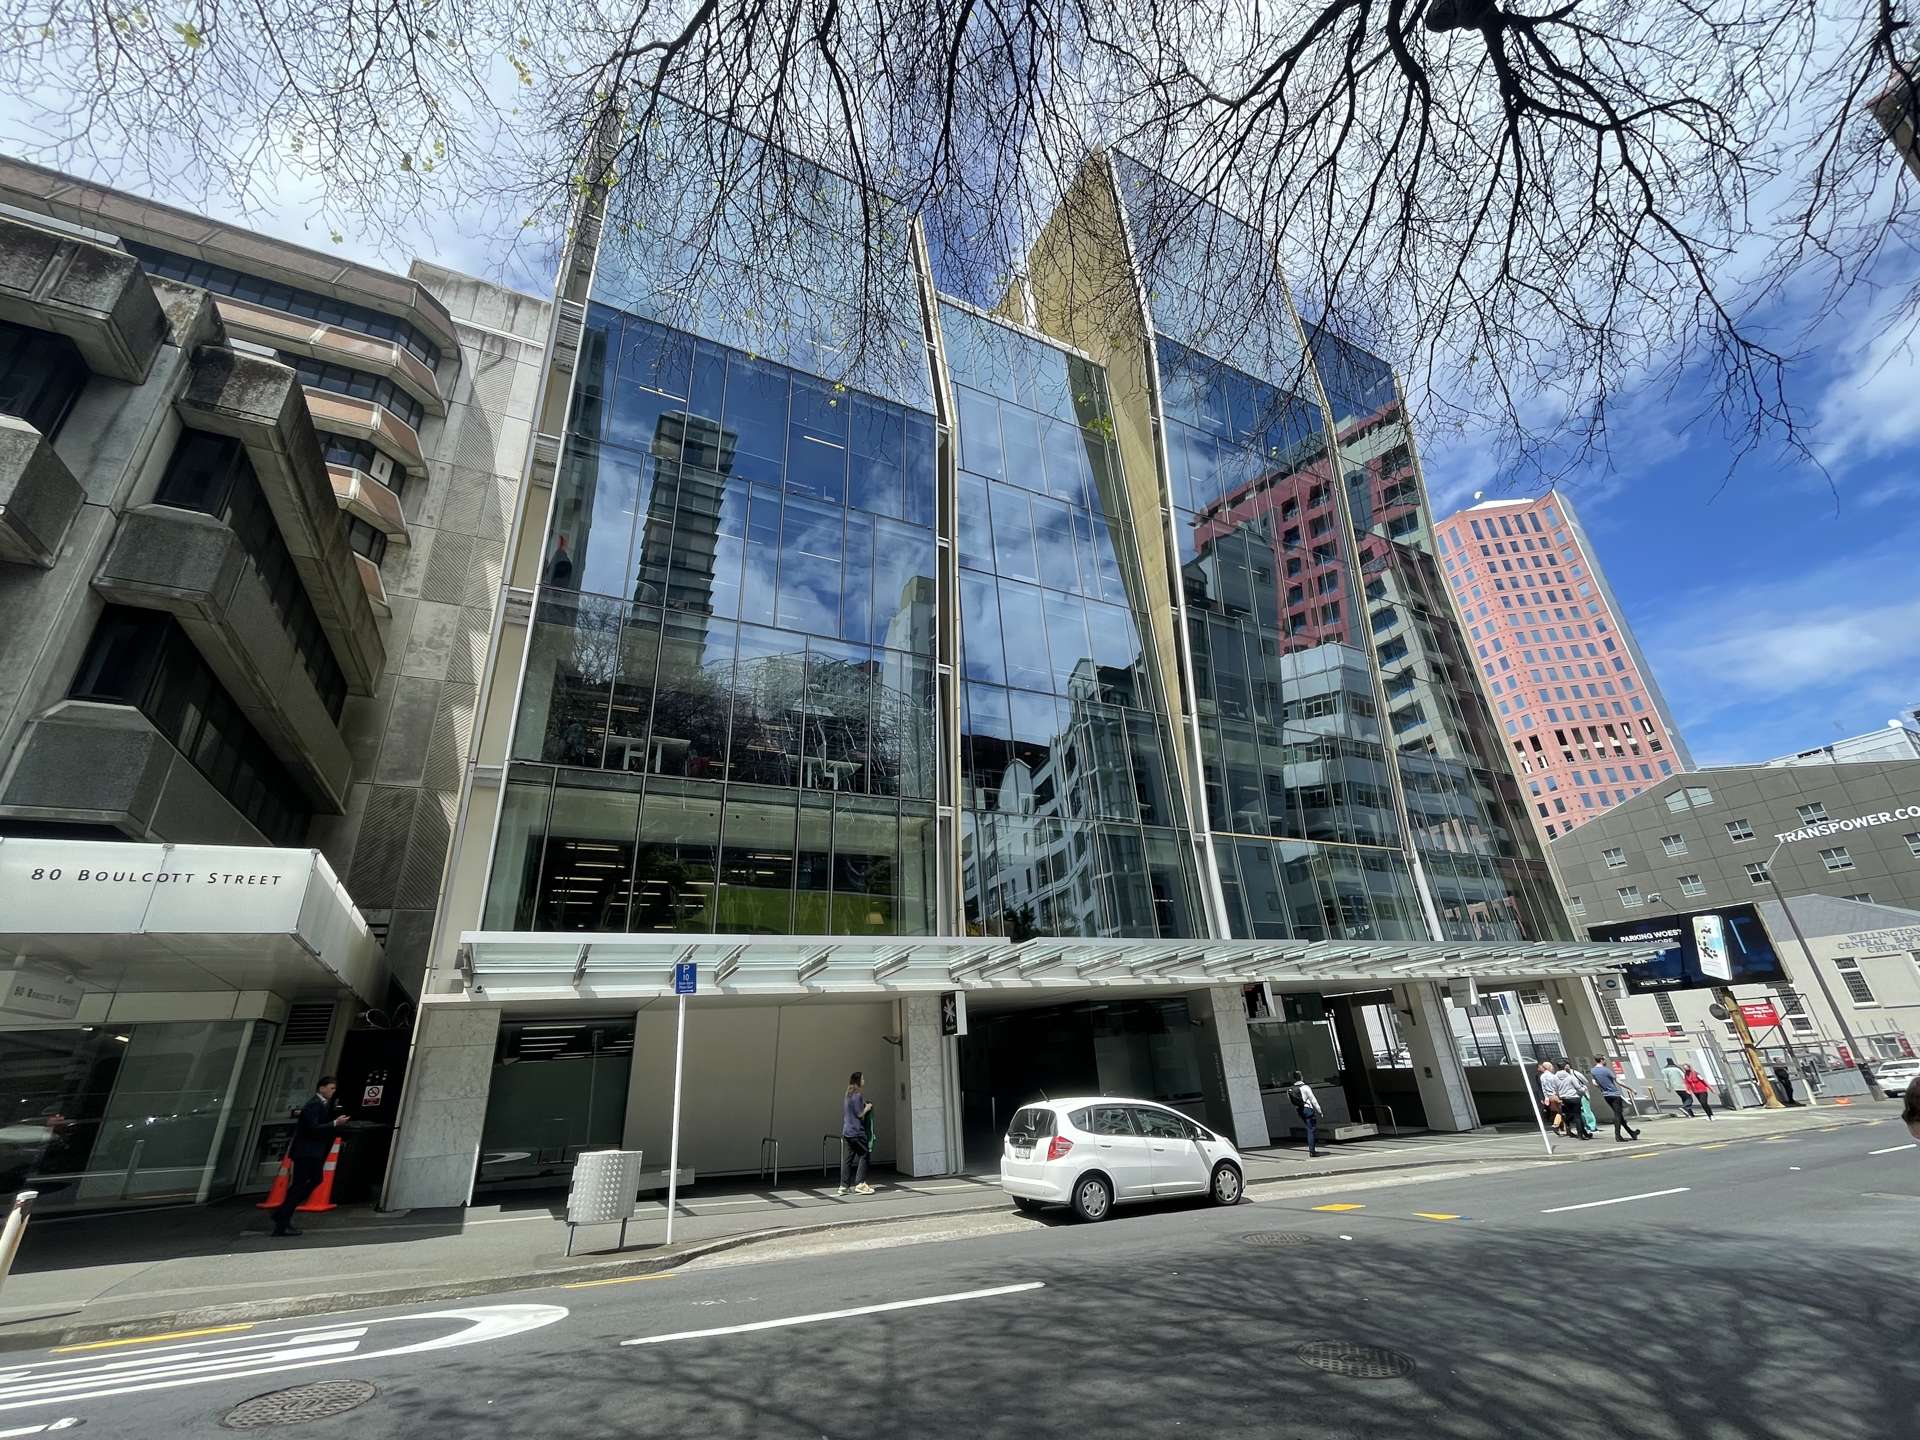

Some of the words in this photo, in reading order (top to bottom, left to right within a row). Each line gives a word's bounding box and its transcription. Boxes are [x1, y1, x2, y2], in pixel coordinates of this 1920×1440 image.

[31, 868, 62, 881] 80
[77, 869, 195, 884] BOULCOTT
[207, 872, 282, 886] STREET
[1620, 932, 1653, 943] PARKING
[1653, 928, 1682, 938] WOES?
[1867, 942, 1915, 953] CHURCH
[683, 964, 690, 973] P
